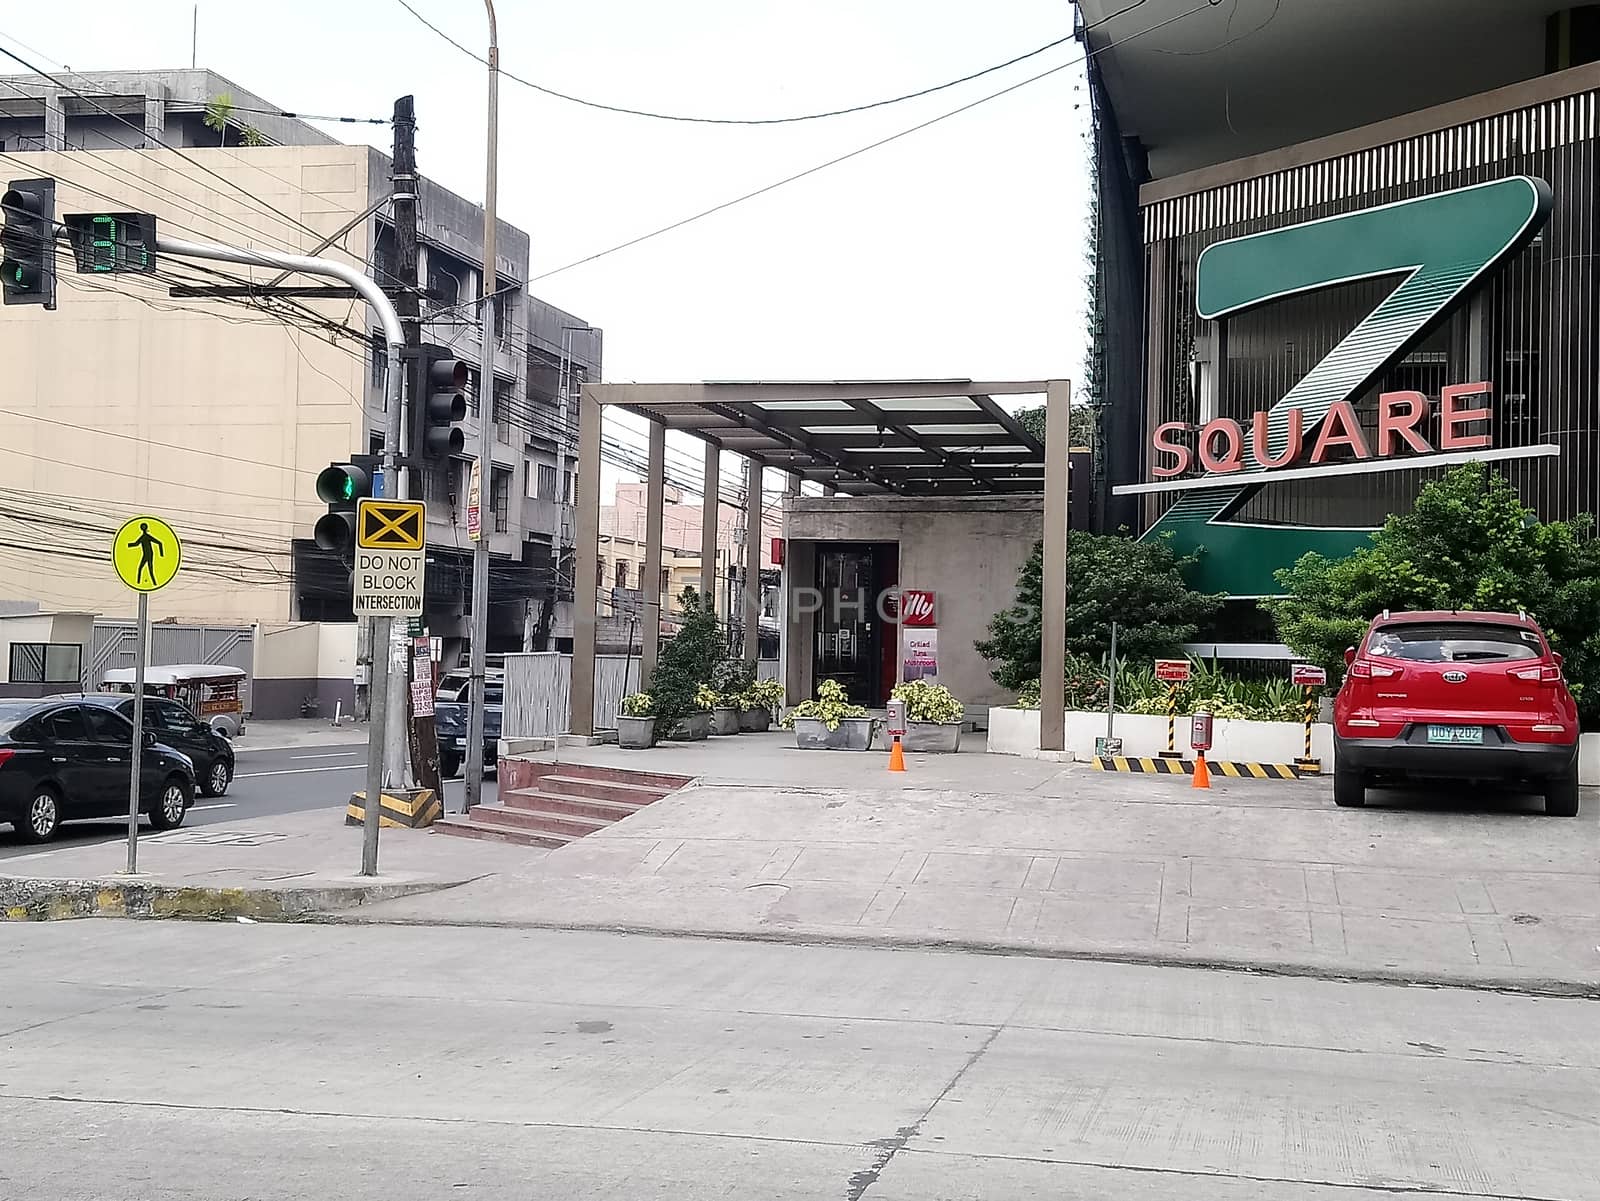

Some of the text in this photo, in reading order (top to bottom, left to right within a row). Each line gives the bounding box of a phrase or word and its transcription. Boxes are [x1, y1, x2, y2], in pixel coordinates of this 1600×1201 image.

[1139, 175, 1550, 599] Z
[1152, 381, 1492, 477] SQUARE
[360, 555, 421, 571] DO NOT
[363, 575, 416, 590] BLOCK
[356, 594, 421, 610] INTERSECTION
[903, 594, 934, 621] illy
